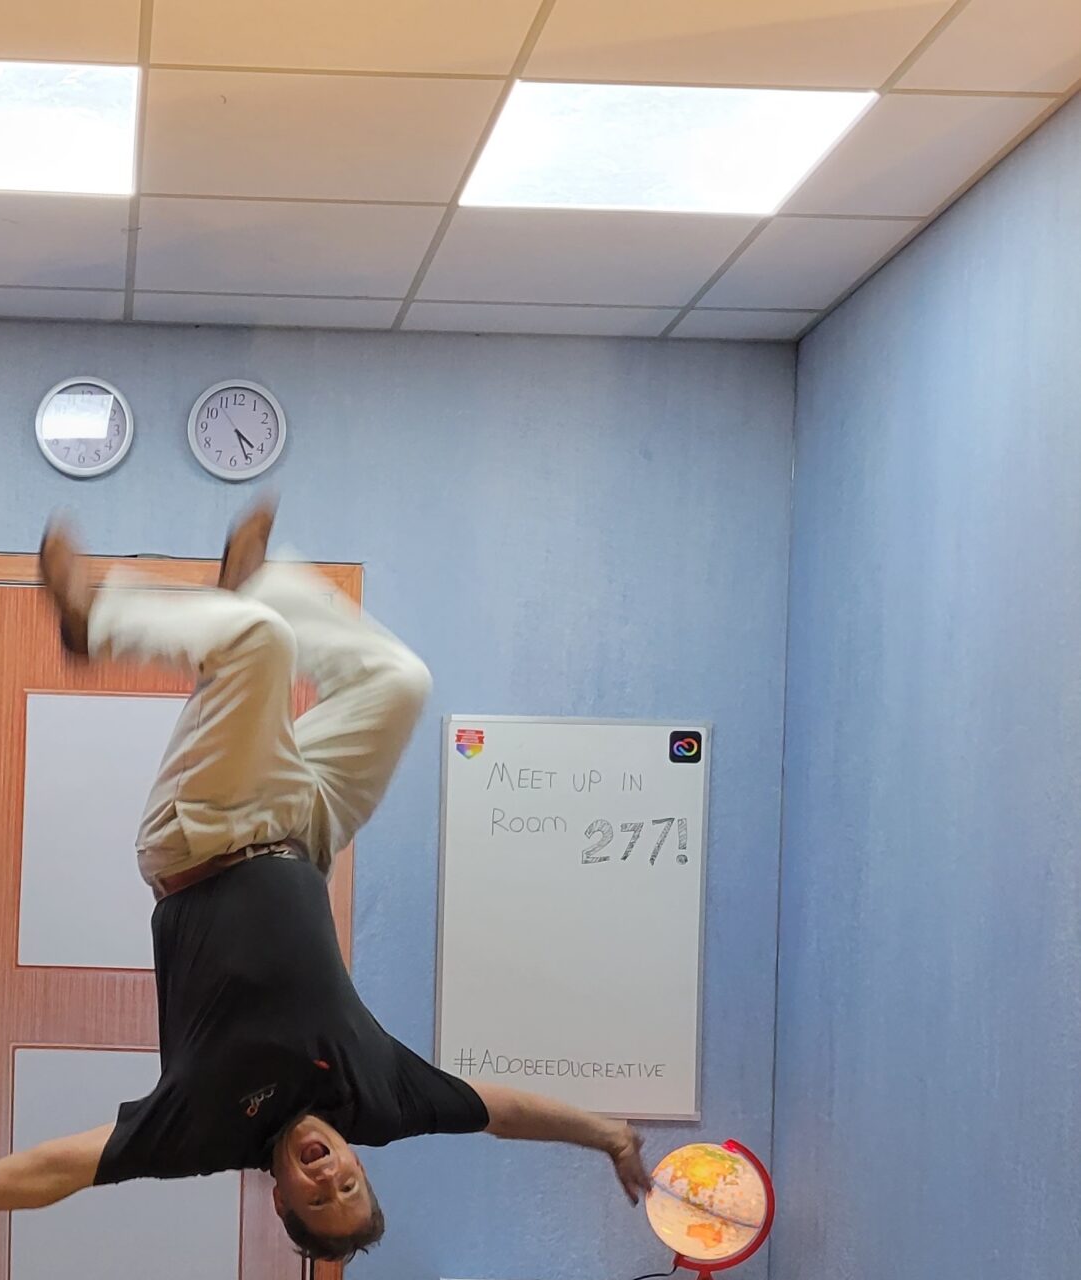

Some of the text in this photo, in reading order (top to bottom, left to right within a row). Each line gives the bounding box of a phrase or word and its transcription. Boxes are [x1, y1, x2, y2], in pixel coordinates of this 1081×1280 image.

[219, 396, 229, 409] 11
[232, 393, 246, 406] 12
[251, 399, 257, 412] 1
[206, 407, 219, 420] 10
[260, 412, 269, 425] 2
[113, 424, 121, 436] 3
[200, 421, 208, 433] 9
[264, 427, 272, 440] 3
[203, 437, 212, 449] 8
[256, 442, 265, 454] 4
[63, 446, 71, 459] 7
[78, 452, 86, 464] 6
[93, 449, 101, 462] 5
[215, 450, 223, 462] 7
[229, 455, 237, 467] 6
[486, 761, 643, 793] MEET UP IN
[490, 808, 689, 867] Room 277!
[453, 1048, 667, 1079] #ADOBEEDUCREATIVE
